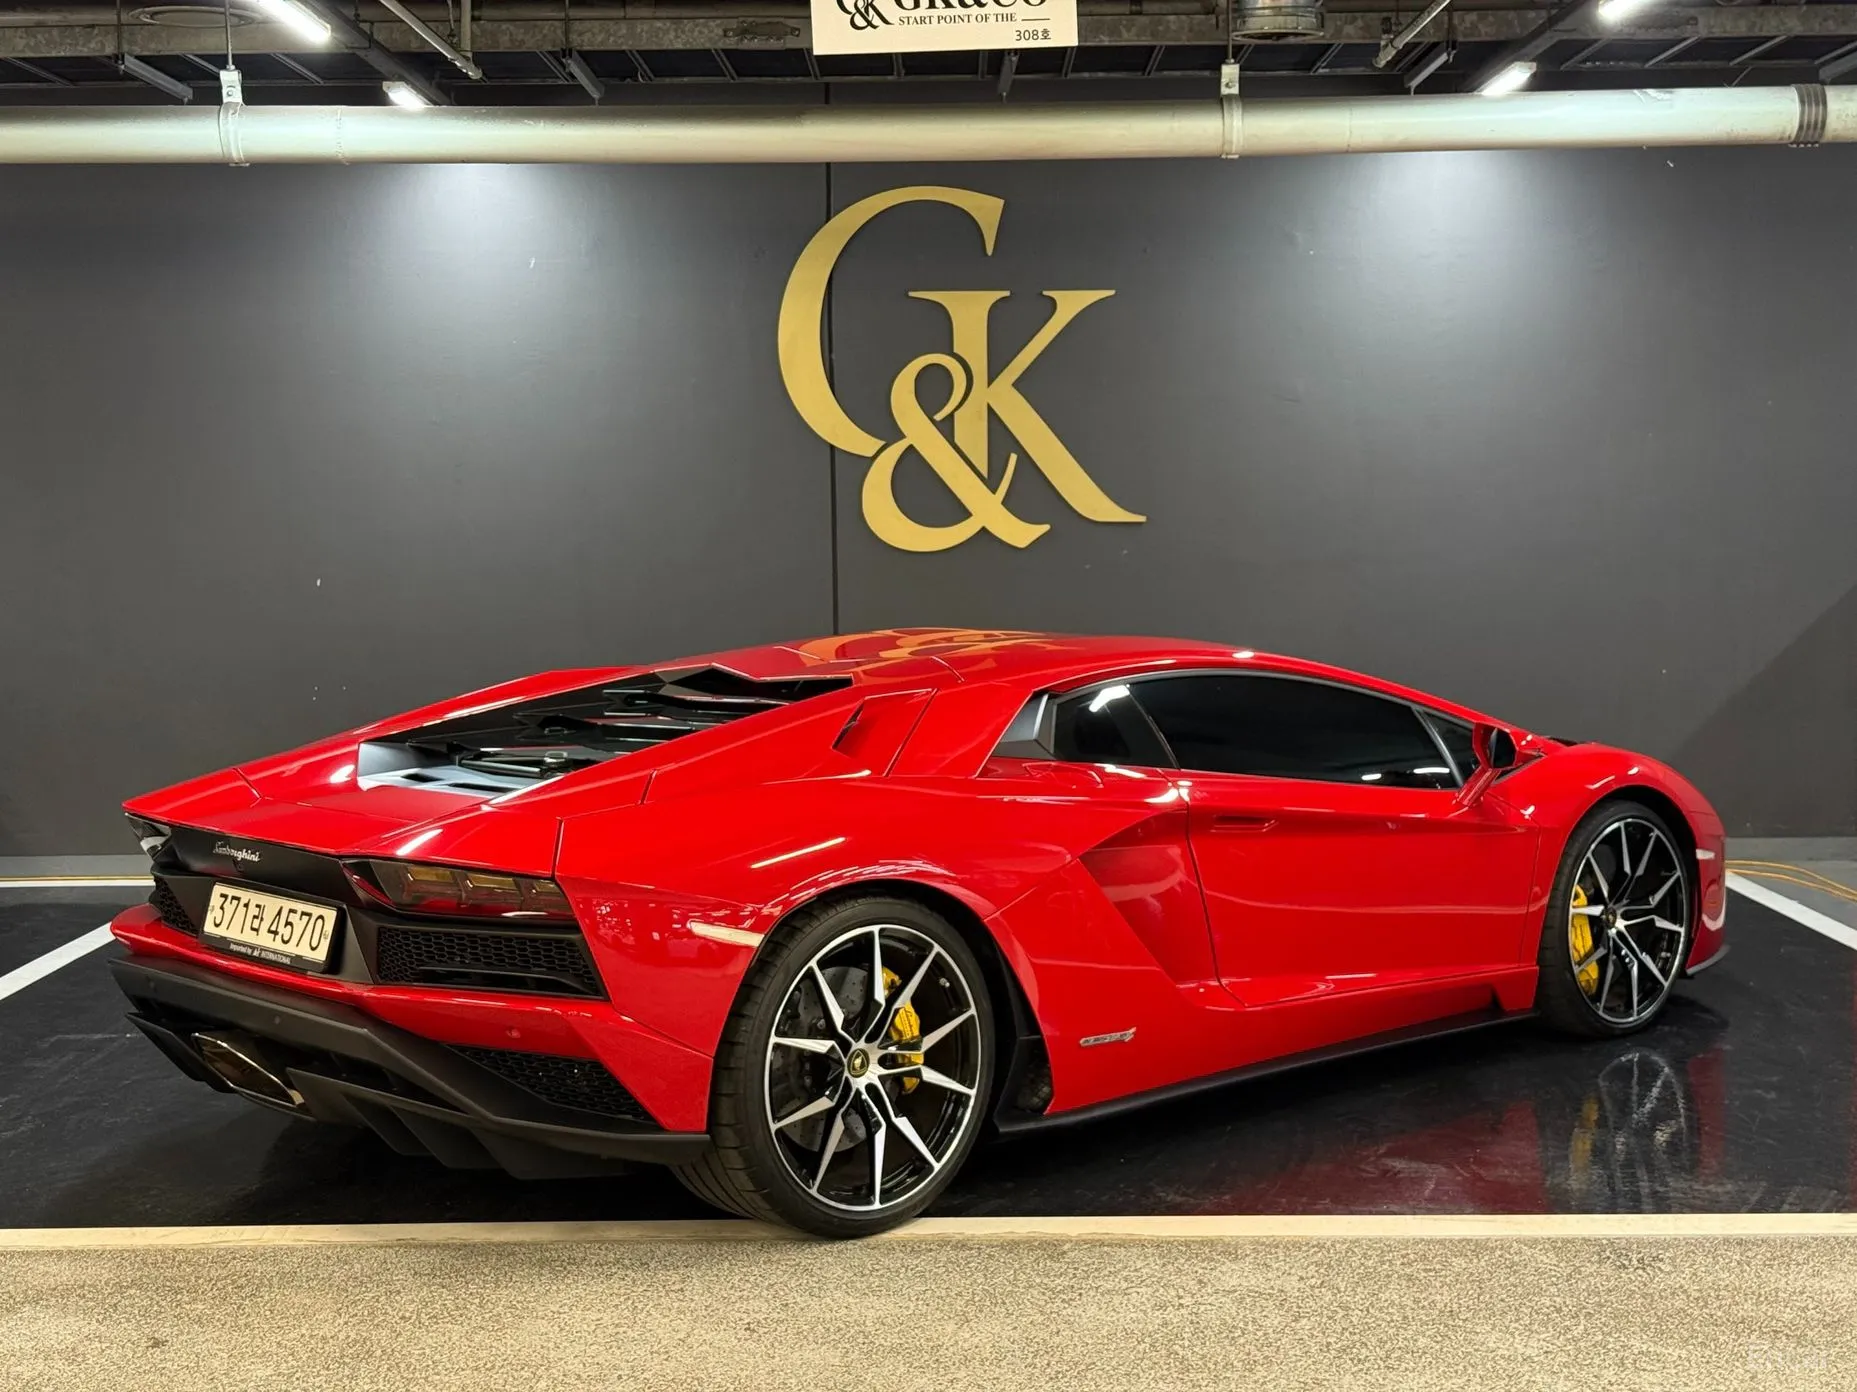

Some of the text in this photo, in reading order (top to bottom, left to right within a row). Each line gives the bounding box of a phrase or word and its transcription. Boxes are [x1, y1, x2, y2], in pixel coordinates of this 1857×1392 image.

[898, 12, 1017, 26] START POINT OF THE
[1015, 28, 1051, 41] 308호
[212, 841, 261, 862] Lamborghini
[213, 893, 325, 951] 371라 4570
